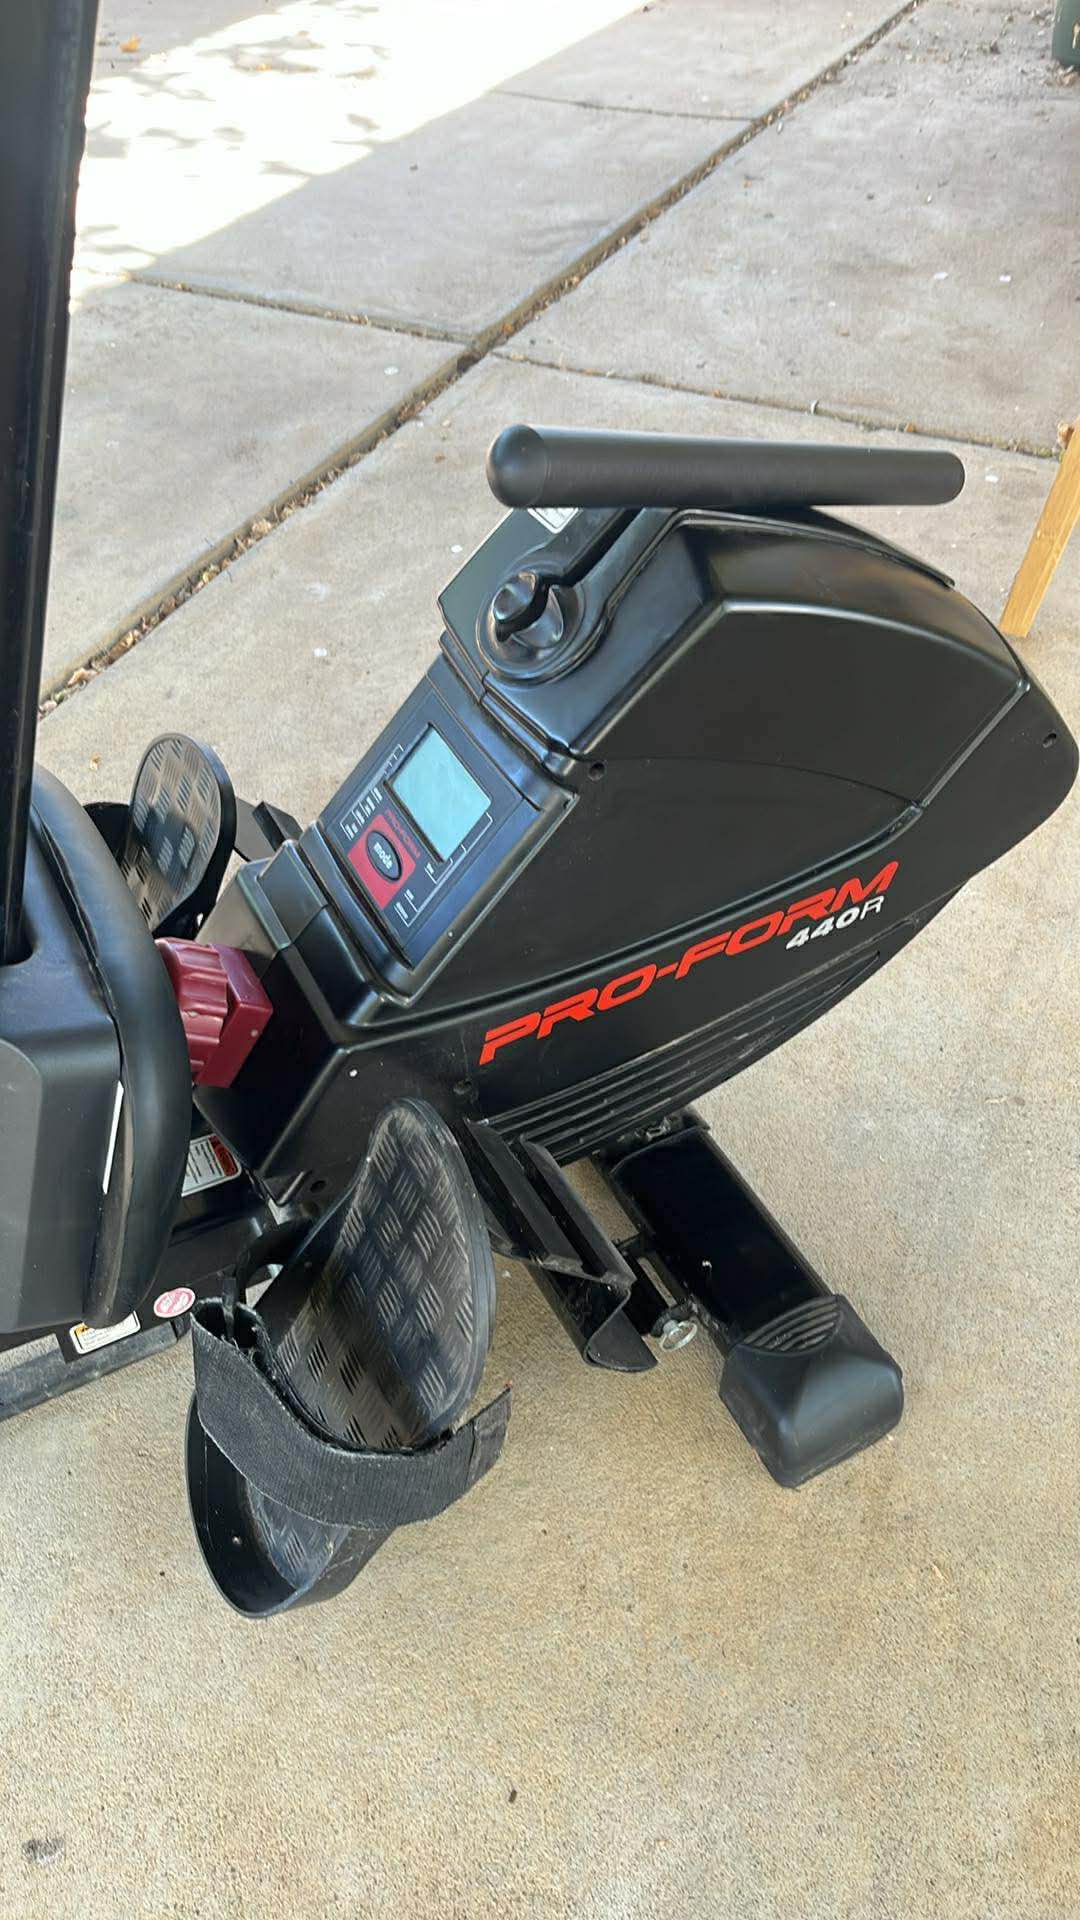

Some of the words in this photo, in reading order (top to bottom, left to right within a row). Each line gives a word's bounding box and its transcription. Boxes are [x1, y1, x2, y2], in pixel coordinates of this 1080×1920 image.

[373, 841, 394, 870] mode
[785, 895, 885, 950] 440R
[479, 861, 899, 1066] PRO-FORM
